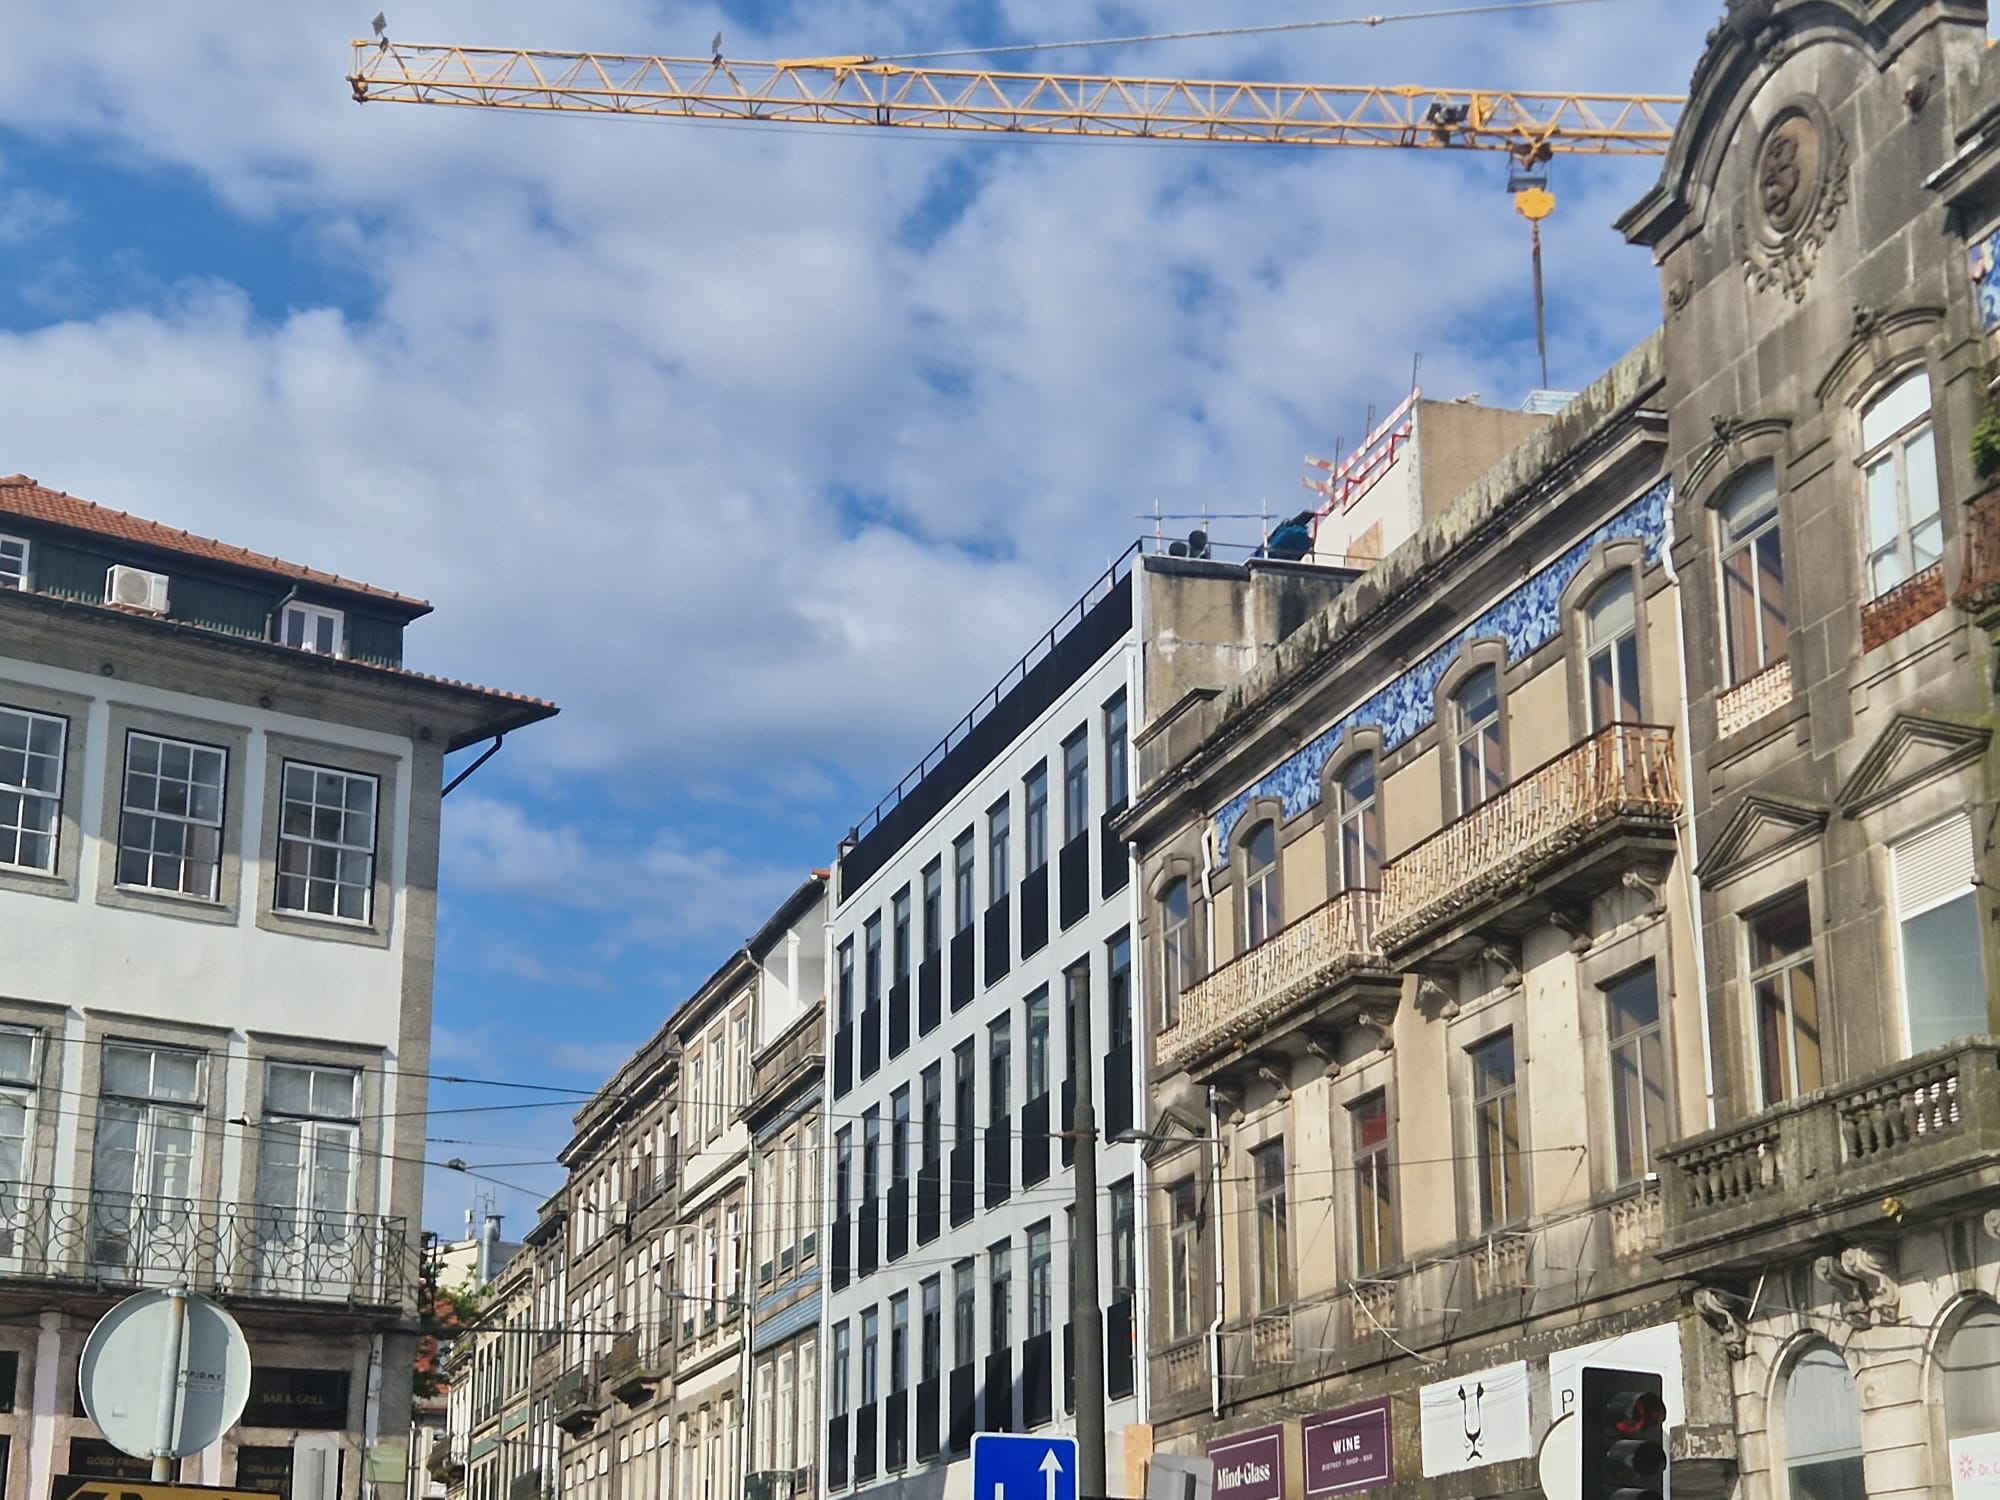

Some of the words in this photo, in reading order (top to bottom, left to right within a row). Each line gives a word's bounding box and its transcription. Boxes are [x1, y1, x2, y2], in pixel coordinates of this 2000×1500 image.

[263, 1393, 283, 1405] BAR
[1562, 1389, 1574, 1413] P
[1332, 1435, 1360, 1455] WINE
[86, 1455, 115, 1466] GOOD
[1217, 1462, 1270, 1491] Mind-Glass
